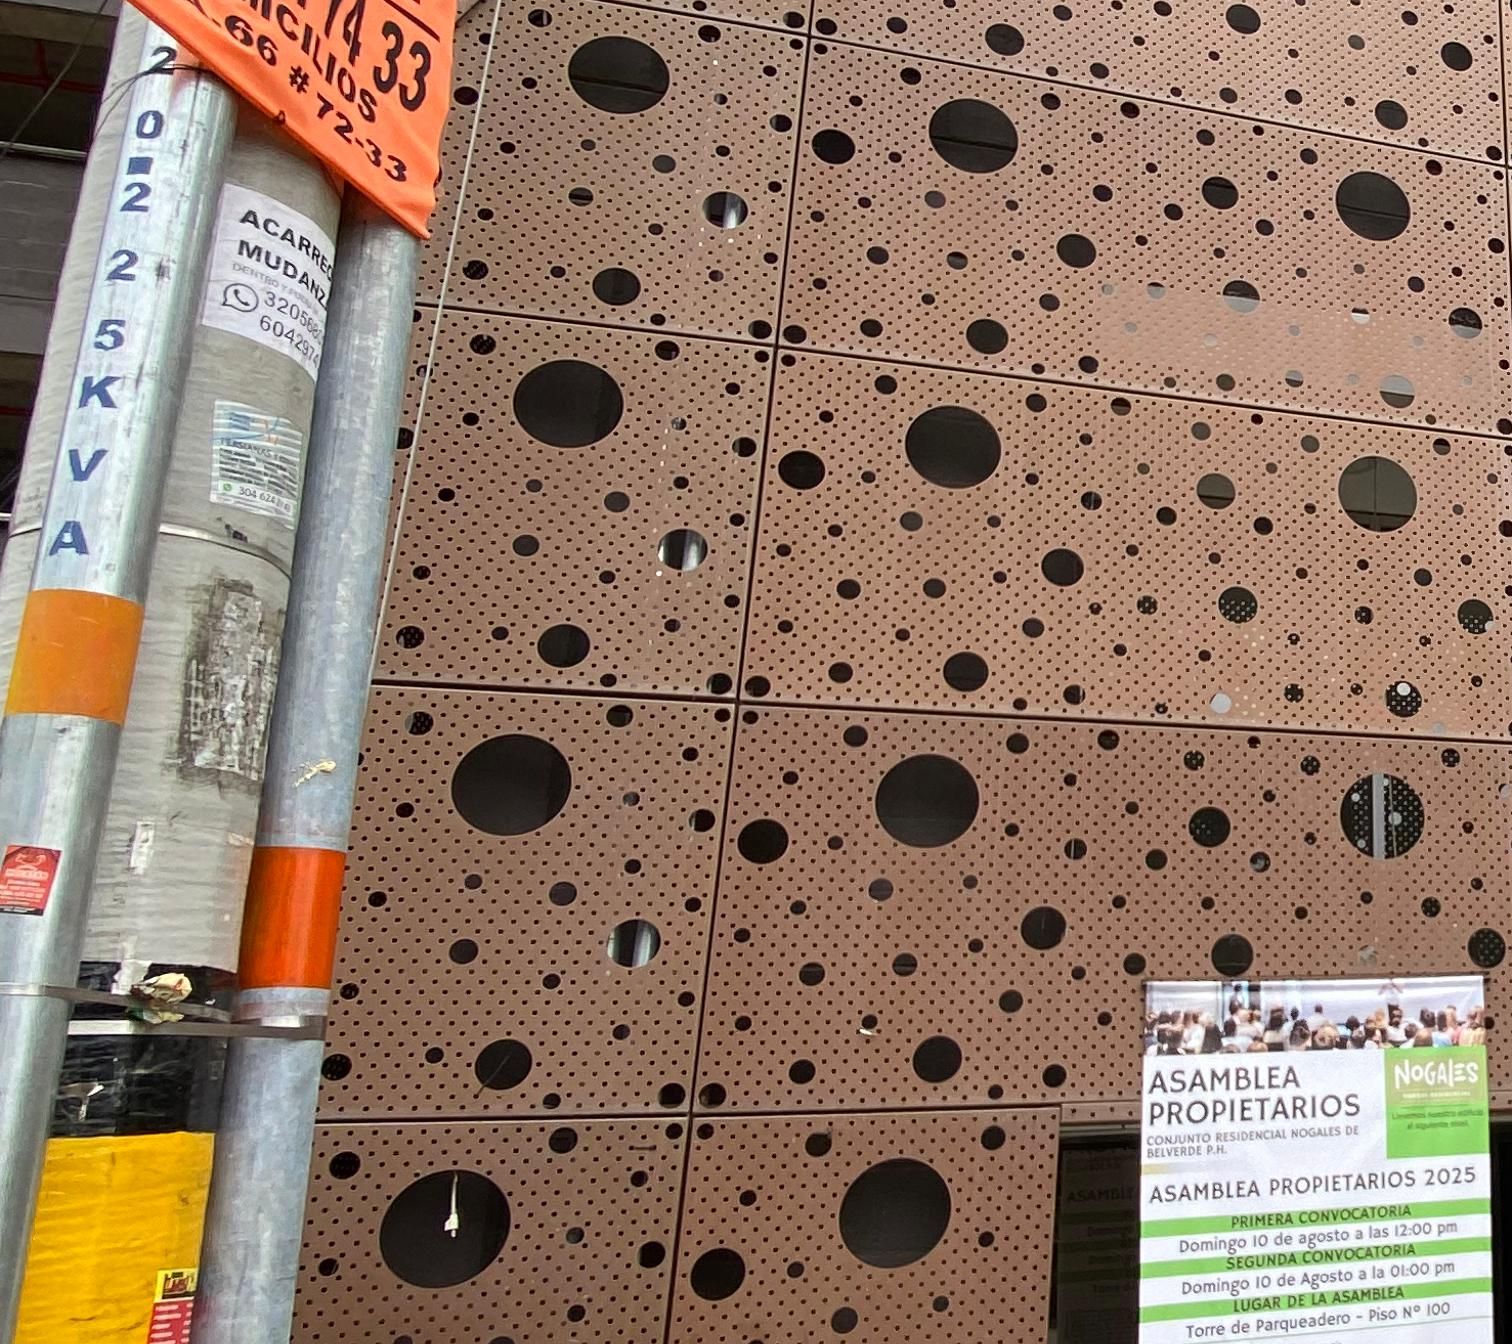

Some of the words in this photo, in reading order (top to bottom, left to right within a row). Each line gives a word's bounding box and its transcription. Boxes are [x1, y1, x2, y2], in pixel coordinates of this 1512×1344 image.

[373, 20, 432, 113] 33
[317, 92, 407, 183] 72-33
[1147, 1065, 1300, 1094] ASAMBLEA
[1149, 1093, 1360, 1126] PROPIETARIOS
[1145, 1132, 1211, 1147] CONJUNTO
[1215, 1128, 1287, 1143] RESIDENCIAL
[1290, 1125, 1341, 1139] NOGALES
[1344, 1124, 1359, 1136] DE
[1146, 1144, 1202, 1159] BELVERDE
[1148, 1179, 1260, 1204] ASAMBLEA
[1269, 1169, 1416, 1196] PROPIETARIOS
[1424, 1165, 1476, 1186] 2025
[1231, 1211, 1294, 1231] PRIMERA
[1297, 1203, 1412, 1225] CONVOCATORIA
[1178, 1235, 1247, 1256] Domingo
[1252, 1233, 1269, 1248] 10
[1272, 1231, 1293, 1246] de
[1297, 1228, 1350, 1250] agosto
[1354, 1228, 1364, 1240] a
[1368, 1224, 1389, 1239] las
[1394, 1221, 1432, 1237] 12:00
[1436, 1222, 1457, 1237] pm
[1225, 1251, 1298, 1271] SEGUNDA
[1298, 1242, 1416, 1265] CONVOCATORIA
[1181, 1277, 1250, 1297] Domingo
[1255, 1274, 1271, 1289] 10
[1276, 1272, 1296, 1287] de
[1299, 1269, 1353, 1290] Agosto
[1357, 1269, 1367, 1281] a
[1371, 1264, 1385, 1280] la
[1389, 1261, 1430, 1278] 01:00
[1434, 1262, 1455, 1277] pm
[1233, 1295, 1281, 1313] LUGAR
[1286, 1293, 1306, 1309] DE
[1310, 1291, 1327, 1306] LA
[1331, 1284, 1405, 1304] ASAMBLEA
[1185, 1324, 1226, 1338] Torre
[1230, 1319, 1250, 1335] de
[1255, 1311, 1351, 1333] Parqueadero
[1368, 1306, 1398, 1322] Piso
[1426, 1301, 1450, 1316] 100
